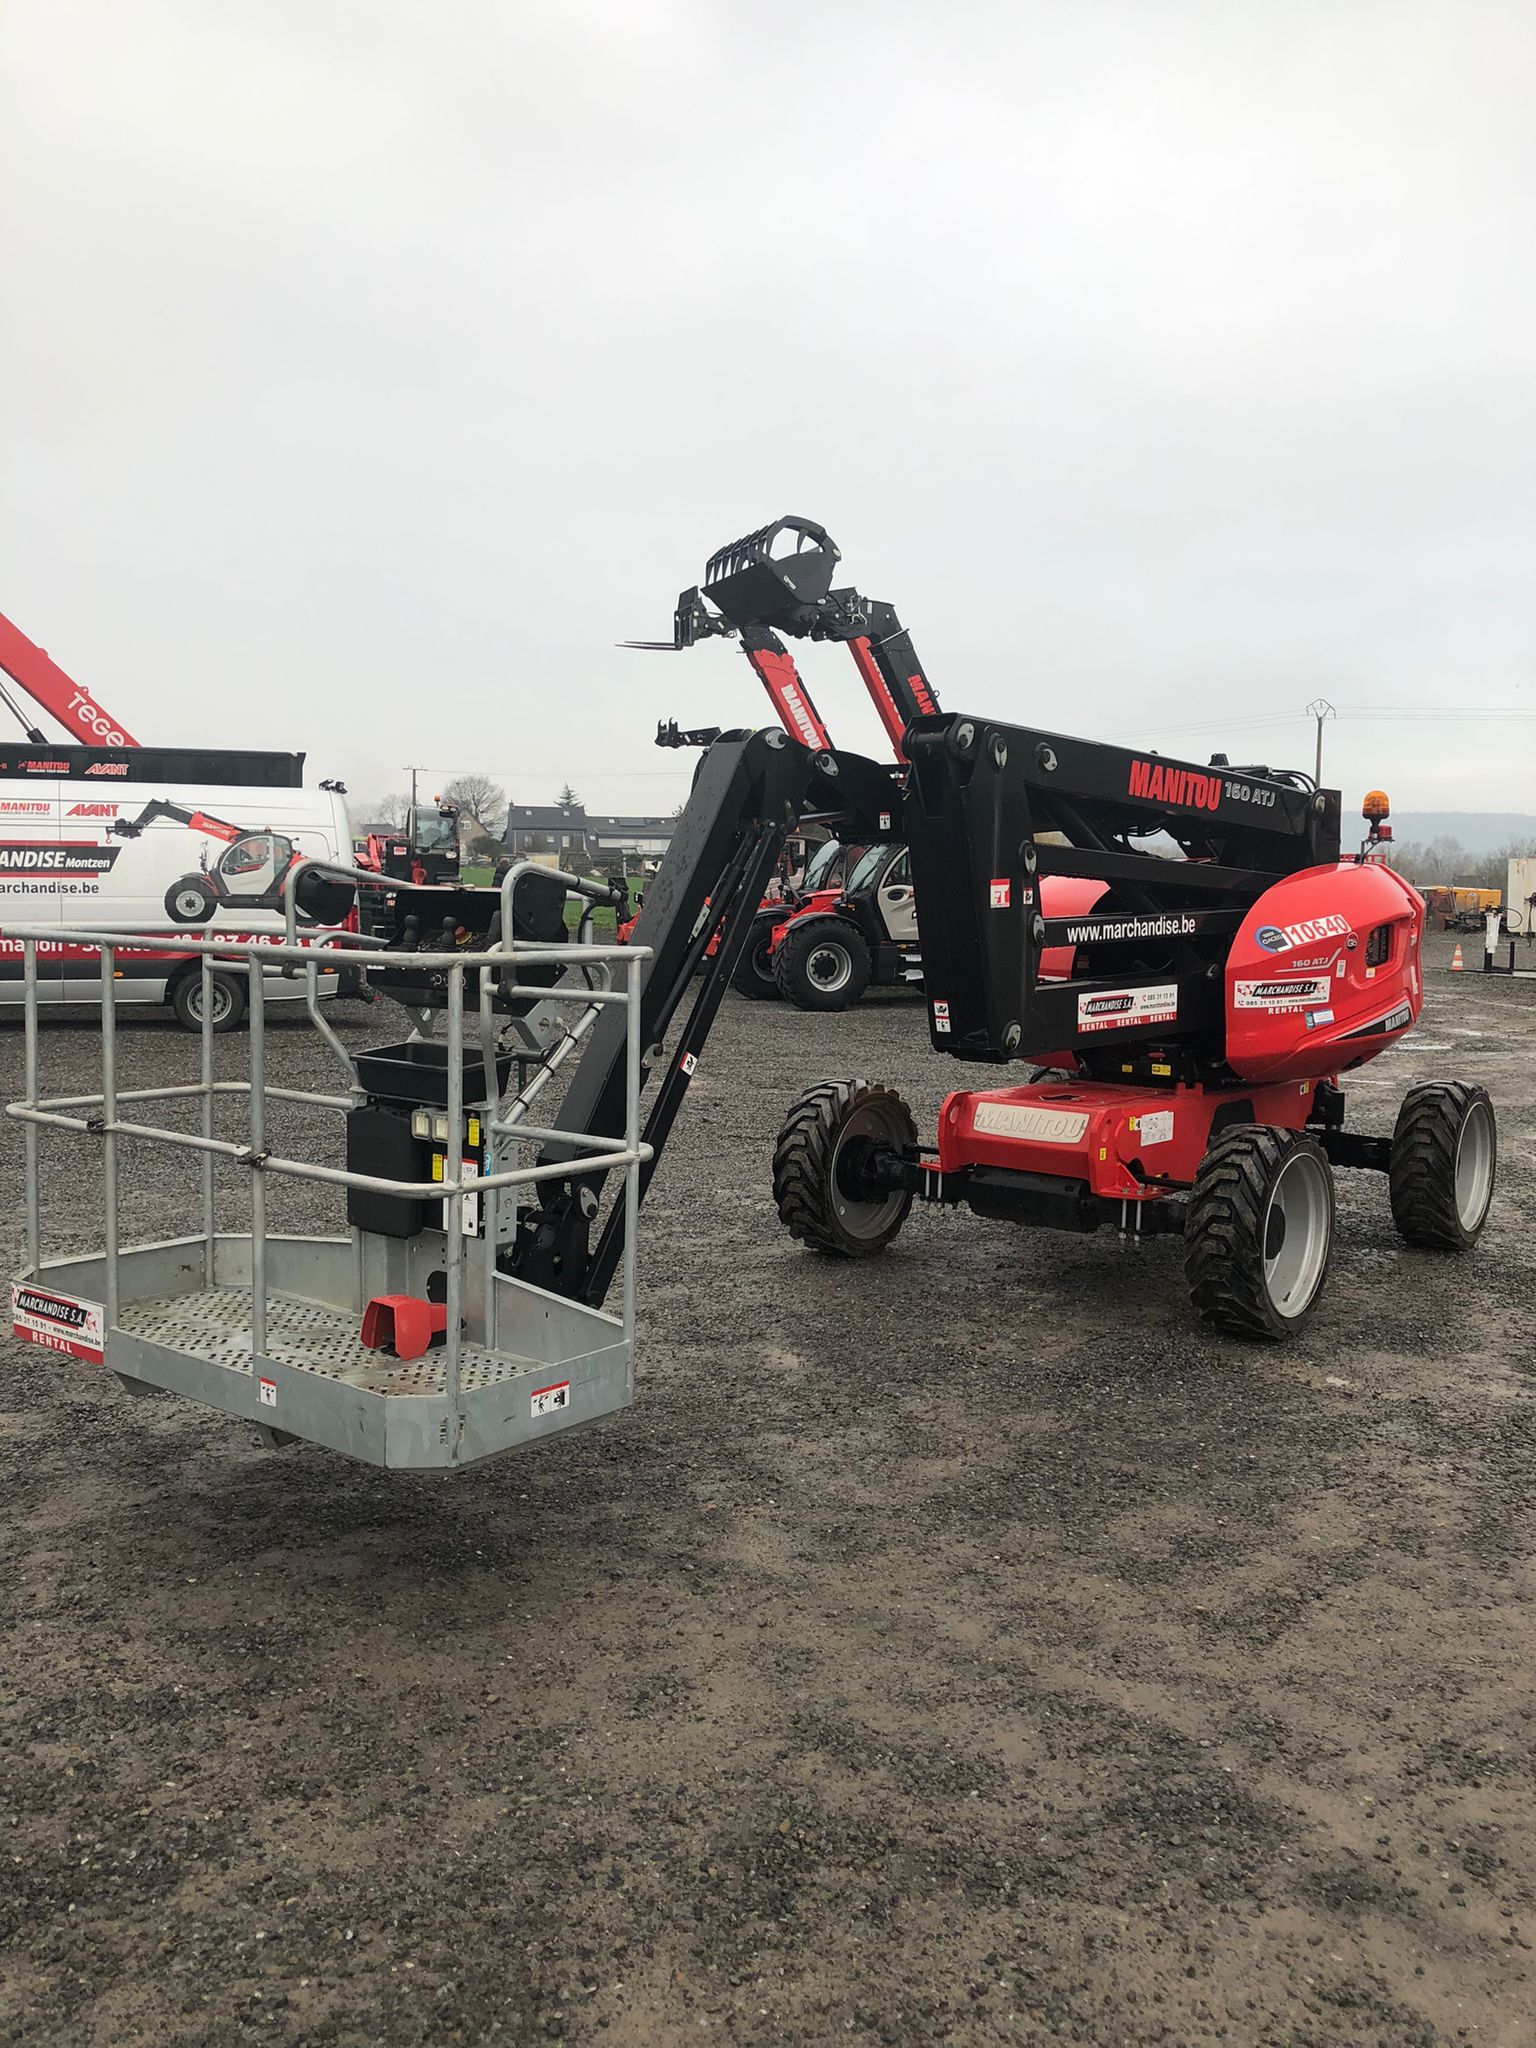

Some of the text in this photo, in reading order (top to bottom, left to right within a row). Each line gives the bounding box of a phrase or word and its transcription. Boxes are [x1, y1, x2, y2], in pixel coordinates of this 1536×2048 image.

[907, 674, 936, 716] MAN
[781, 683, 823, 751] MANITOU
[27, 761, 70, 769] MANITOU
[84, 763, 129, 775] AVANT
[1128, 760, 1222, 811] MANITOU
[1225, 781, 1276, 807] 160 ATJ
[1, 802, 50, 811] MANITOU
[65, 804, 119, 816] AVANT
[65, 858, 111, 868] Montzen
[1067, 914, 1196, 943] www.marchandise.be
[1290, 915, 1351, 943] 10640
[1292, 957, 1329, 967] 160 ATJ
[1255, 984, 1304, 996] MARCHANDISE
[1087, 1000, 1122, 1013] MARCHANDISE
[1268, 1006, 1304, 1015] RENTAL
[1081, 1012, 1174, 1032] RENTAL RENTAL RENTAL
[20, 1294, 84, 1325] MARCHANDISE S.A.
[32, 1331, 72, 1353] RENTAL
